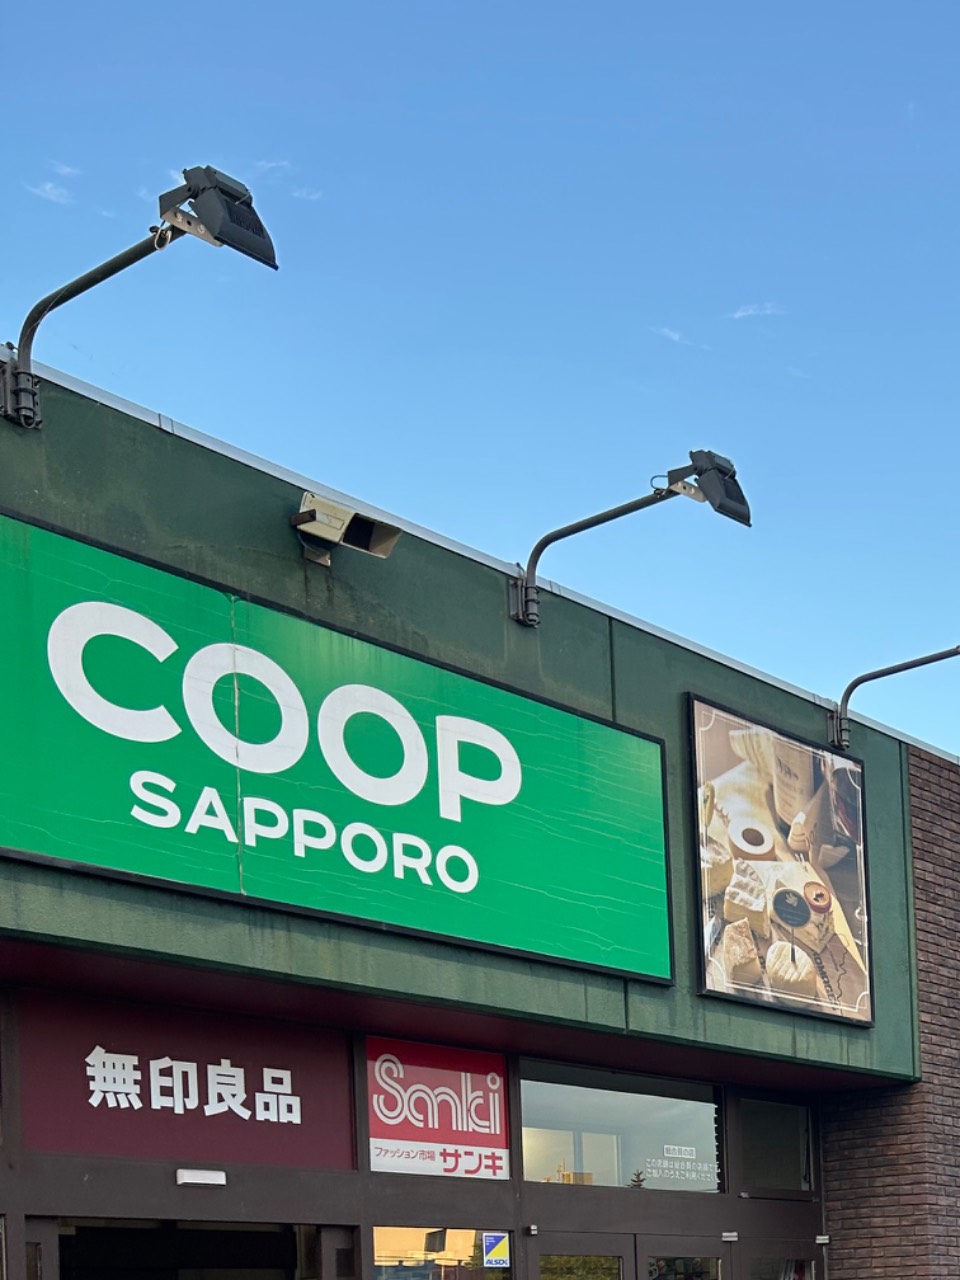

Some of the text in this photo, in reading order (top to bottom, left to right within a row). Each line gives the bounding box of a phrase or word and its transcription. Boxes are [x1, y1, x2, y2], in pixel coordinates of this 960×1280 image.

[47, 600, 523, 822] COOP
[129, 769, 480, 894] SAPPORO
[85, 1044, 303, 1125] 無印良品
[372, 1053, 502, 1135] Sanki
[374, 1146, 504, 1176] ファッション市場 サンキ
